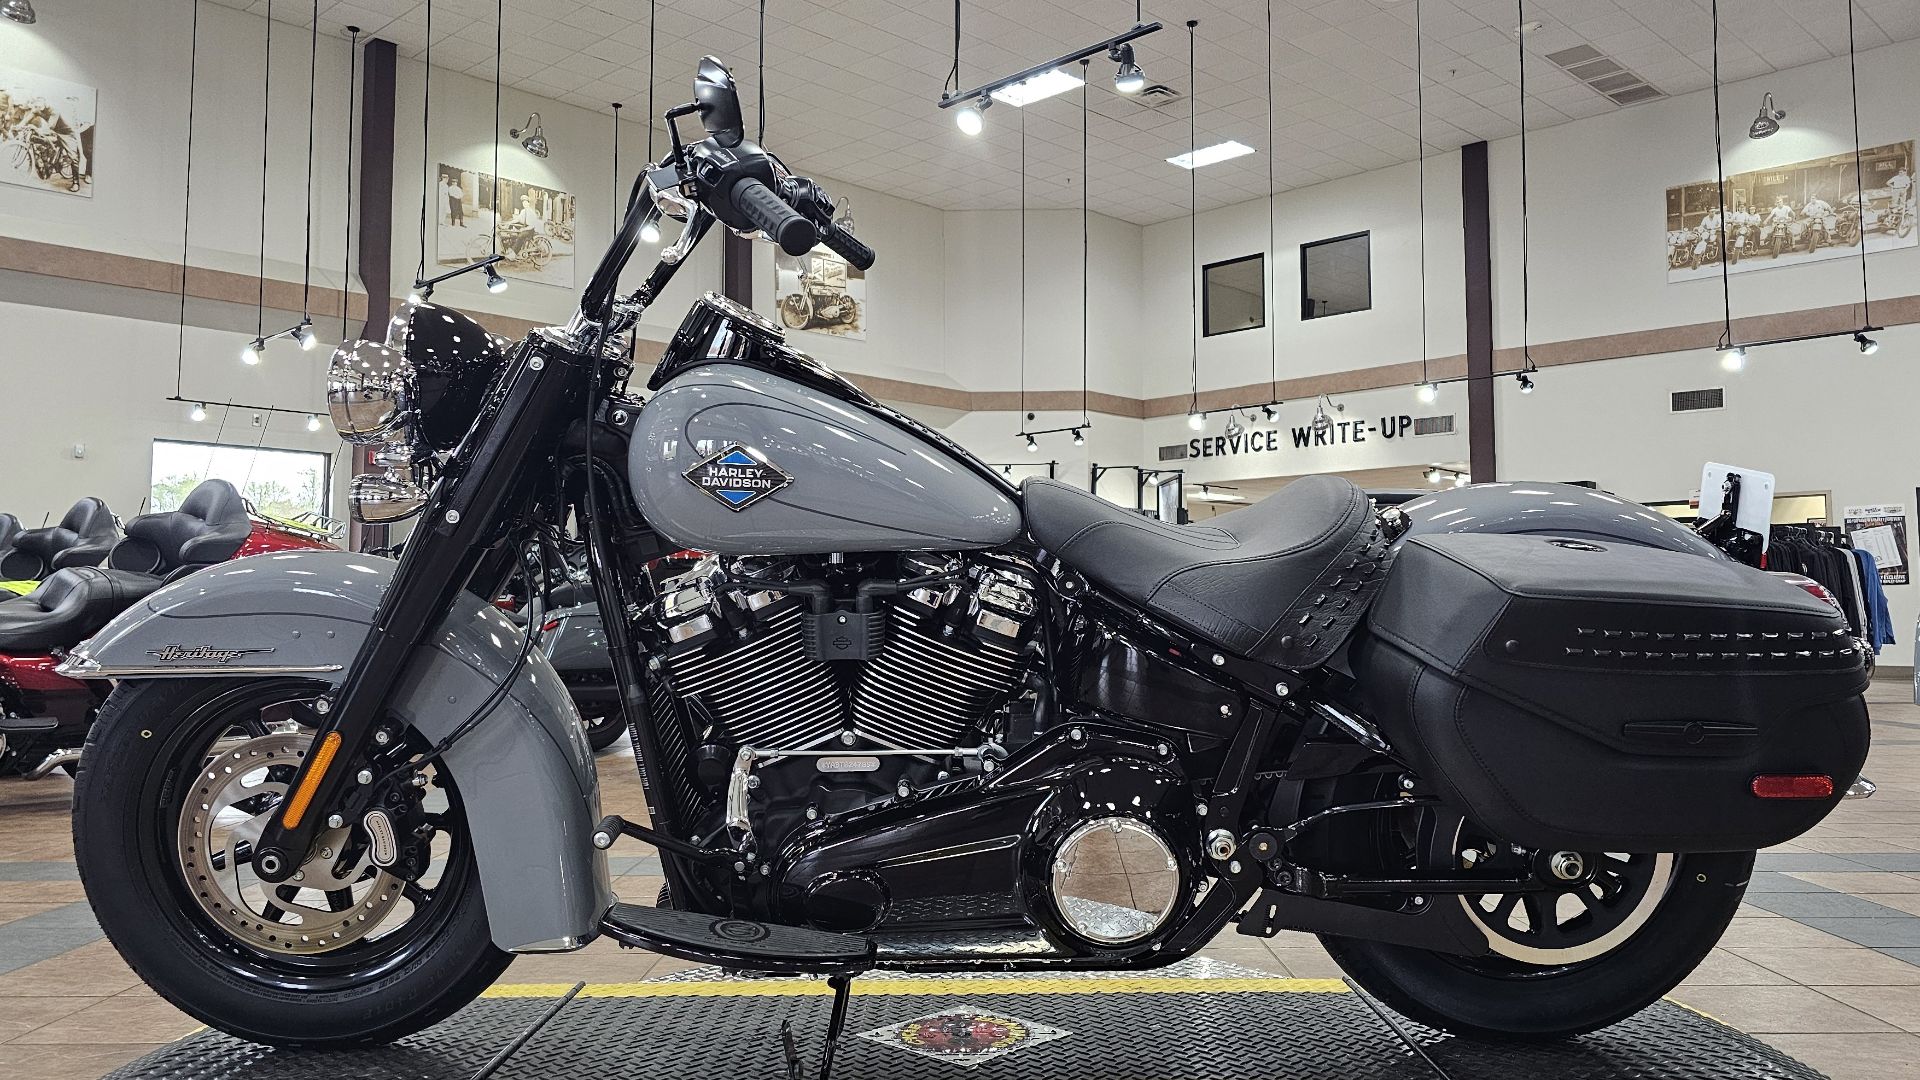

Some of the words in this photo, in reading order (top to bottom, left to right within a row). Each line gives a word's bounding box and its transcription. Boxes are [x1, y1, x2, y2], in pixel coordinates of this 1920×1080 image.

[1189, 430, 1278, 458] SERVICE
[1291, 415, 1412, 449] WRITE-UP
[702, 477, 771, 488] DAVIDSON
[158, 643, 244, 664] Heritage
